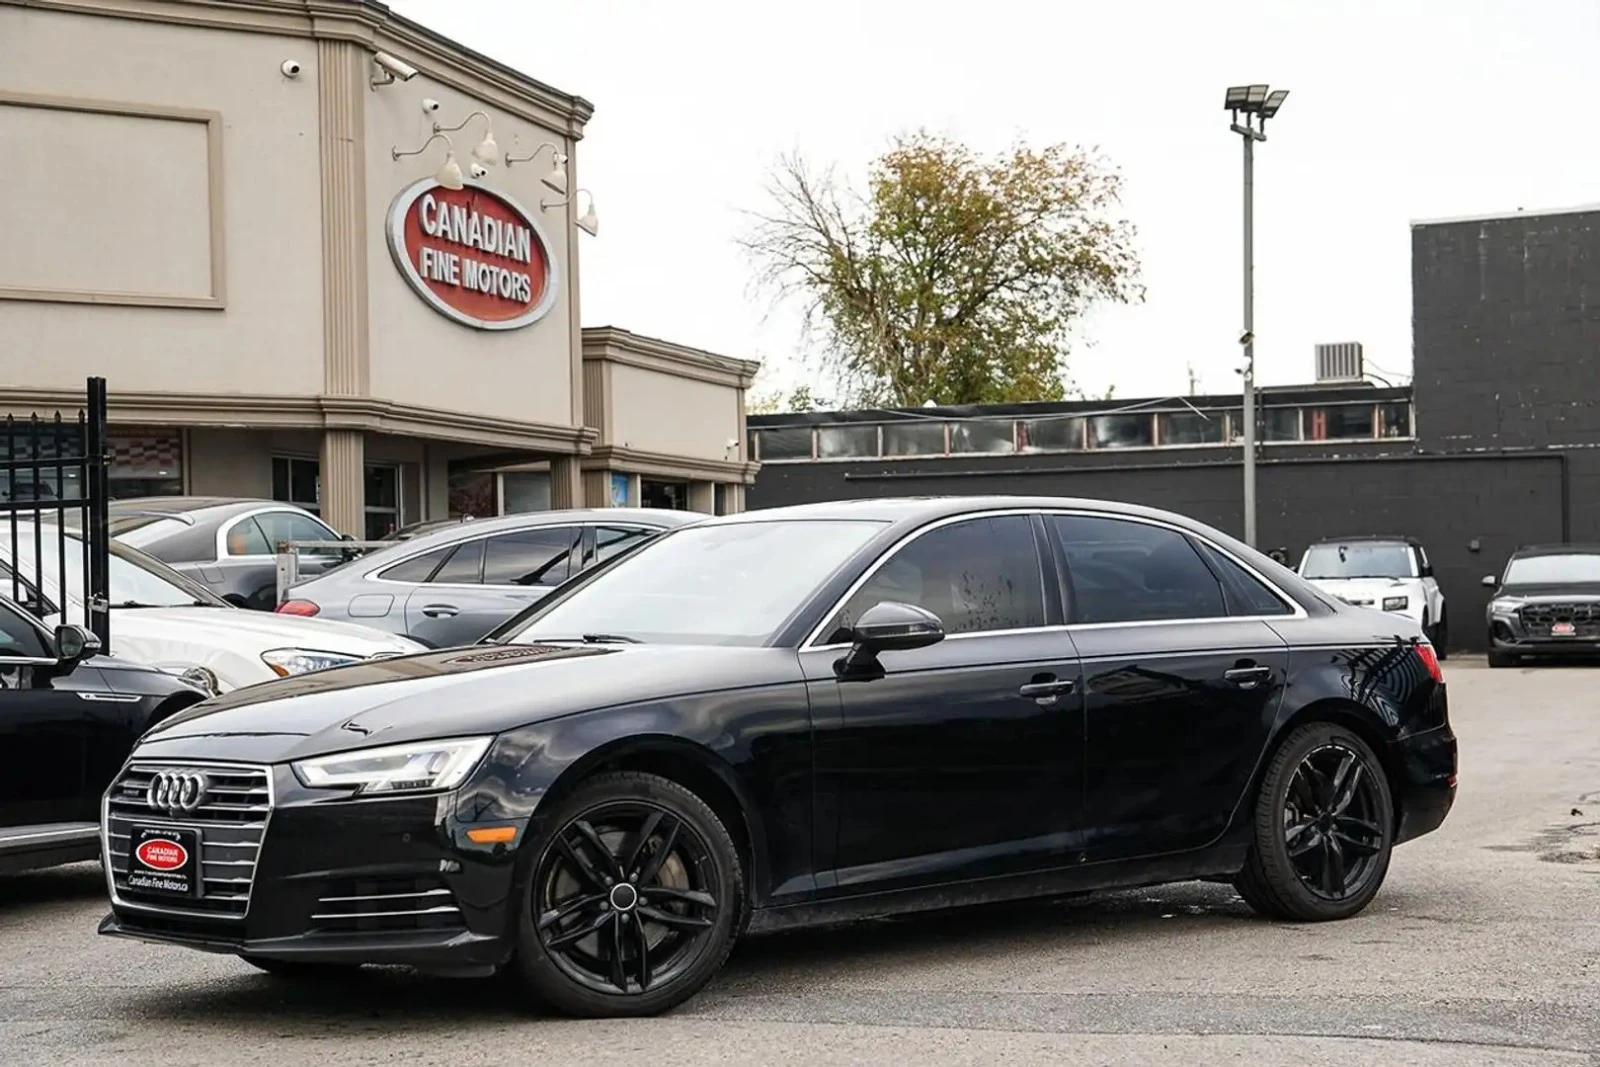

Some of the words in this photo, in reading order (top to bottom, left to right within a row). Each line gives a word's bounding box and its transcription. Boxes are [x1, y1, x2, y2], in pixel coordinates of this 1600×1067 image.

[421, 194, 531, 263] CANADIAN
[420, 247, 460, 285] FINE
[462, 258, 531, 303] MOTORS
[147, 846, 178, 856] CANADIAN
